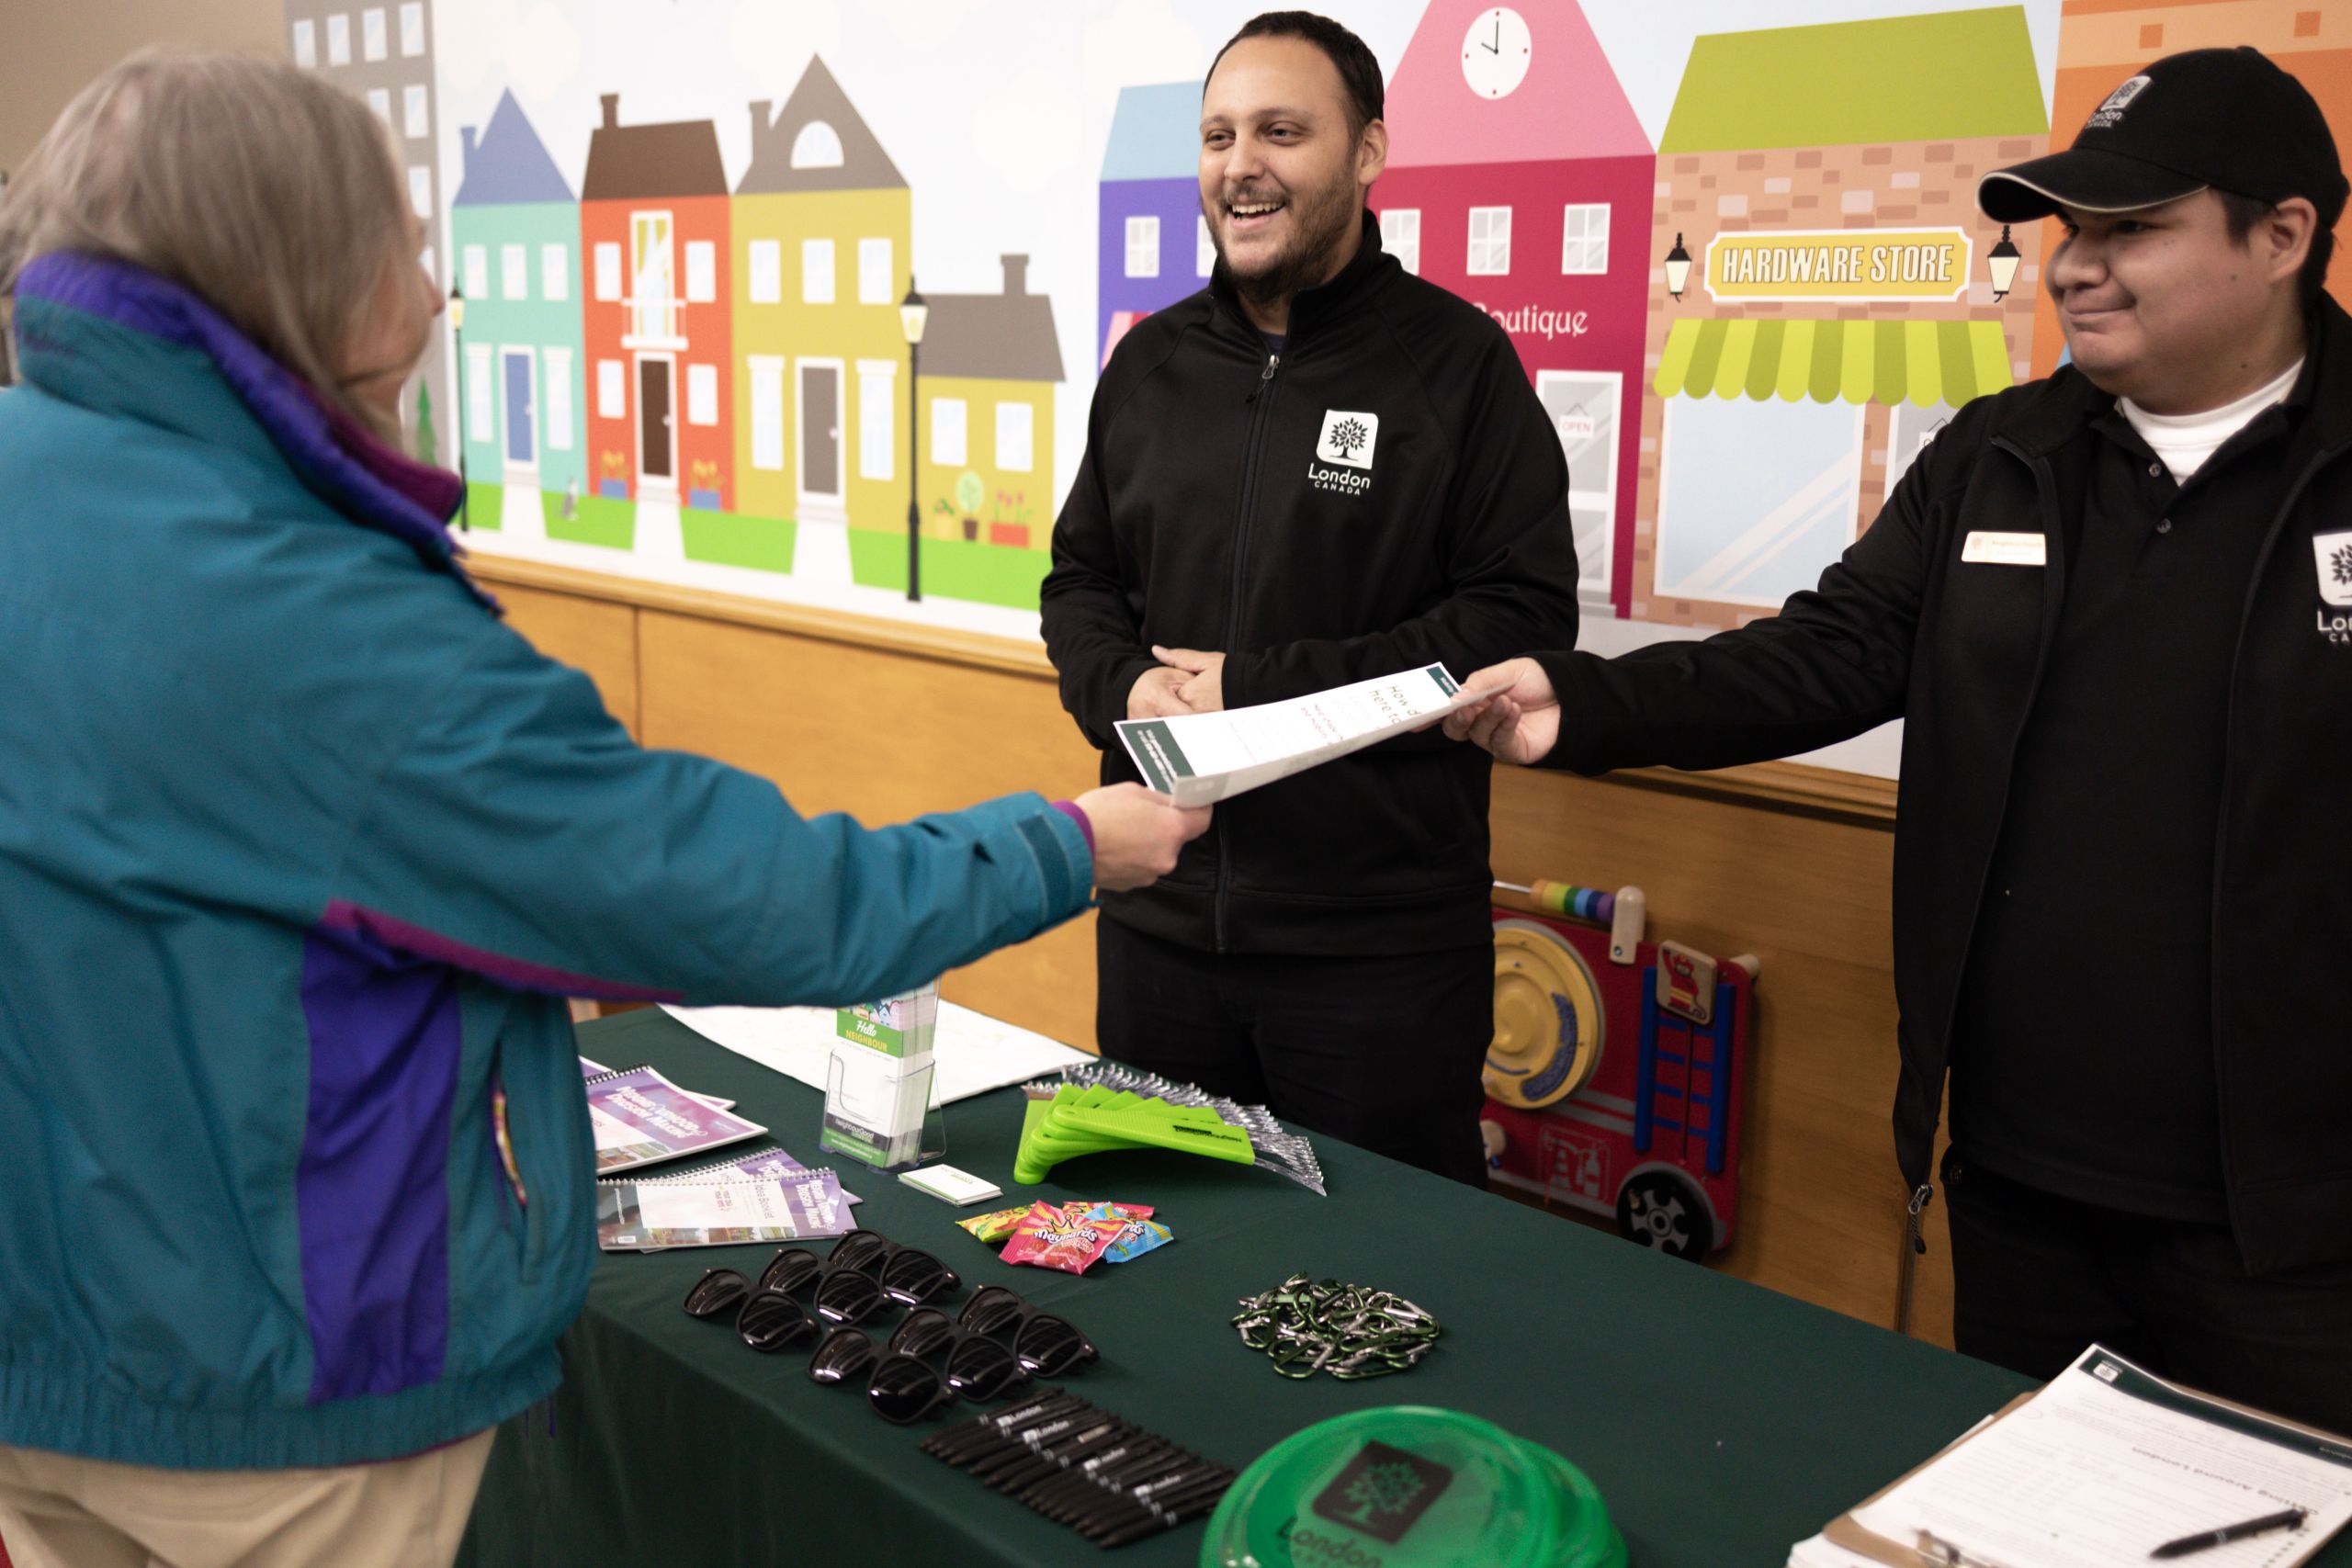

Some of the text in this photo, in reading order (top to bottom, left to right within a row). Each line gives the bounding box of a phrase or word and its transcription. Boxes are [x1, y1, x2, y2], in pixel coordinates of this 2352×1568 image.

[1721, 244, 1955, 284] HARDWARE STORE
[1562, 420, 1591, 433] OPEN
[1307, 462, 1371, 490] London
[1314, 480, 1361, 496] CANADA
[855, 1020, 877, 1037] Hello
[845, 1029, 888, 1053] NEIGHBOUR
